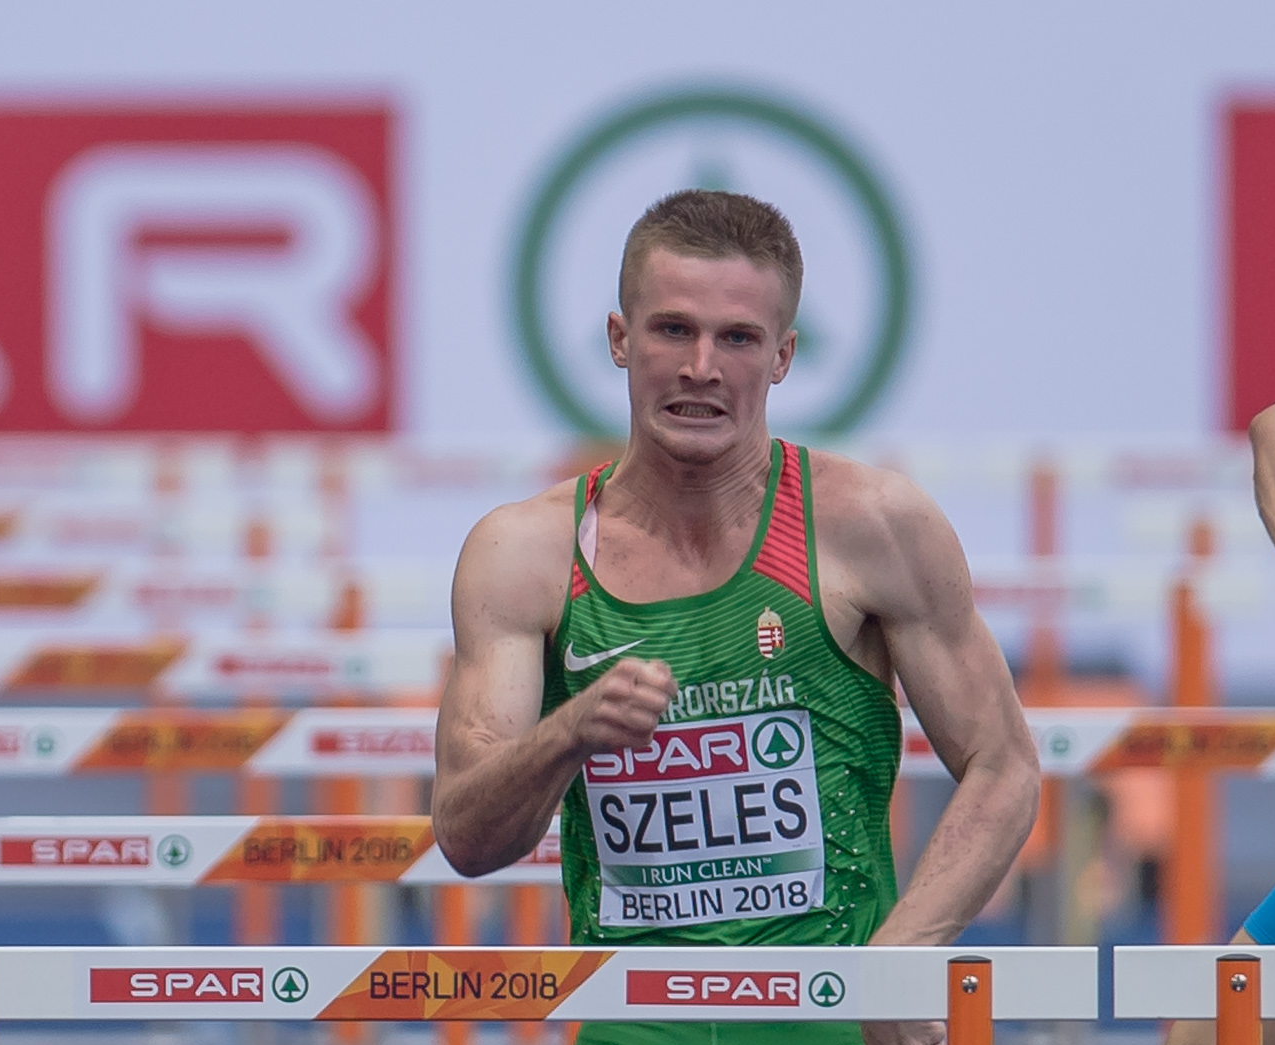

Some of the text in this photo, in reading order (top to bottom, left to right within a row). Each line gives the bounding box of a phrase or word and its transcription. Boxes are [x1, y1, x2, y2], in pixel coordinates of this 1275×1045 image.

[659, 669, 796, 722] RORSZÁG
[590, 731, 743, 776] SPAR
[600, 778, 807, 853] SZELES
[31, 840, 149, 862] SPAR
[245, 839, 343, 865] BERLIN
[642, 869, 647, 883] I
[650, 865, 692, 883] RUN
[622, 880, 808, 920] BERLIN 2018
[130, 973, 261, 997] SPAR
[370, 972, 558, 1000] BERLIN 2018
[666, 975, 798, 1000] SPAR
